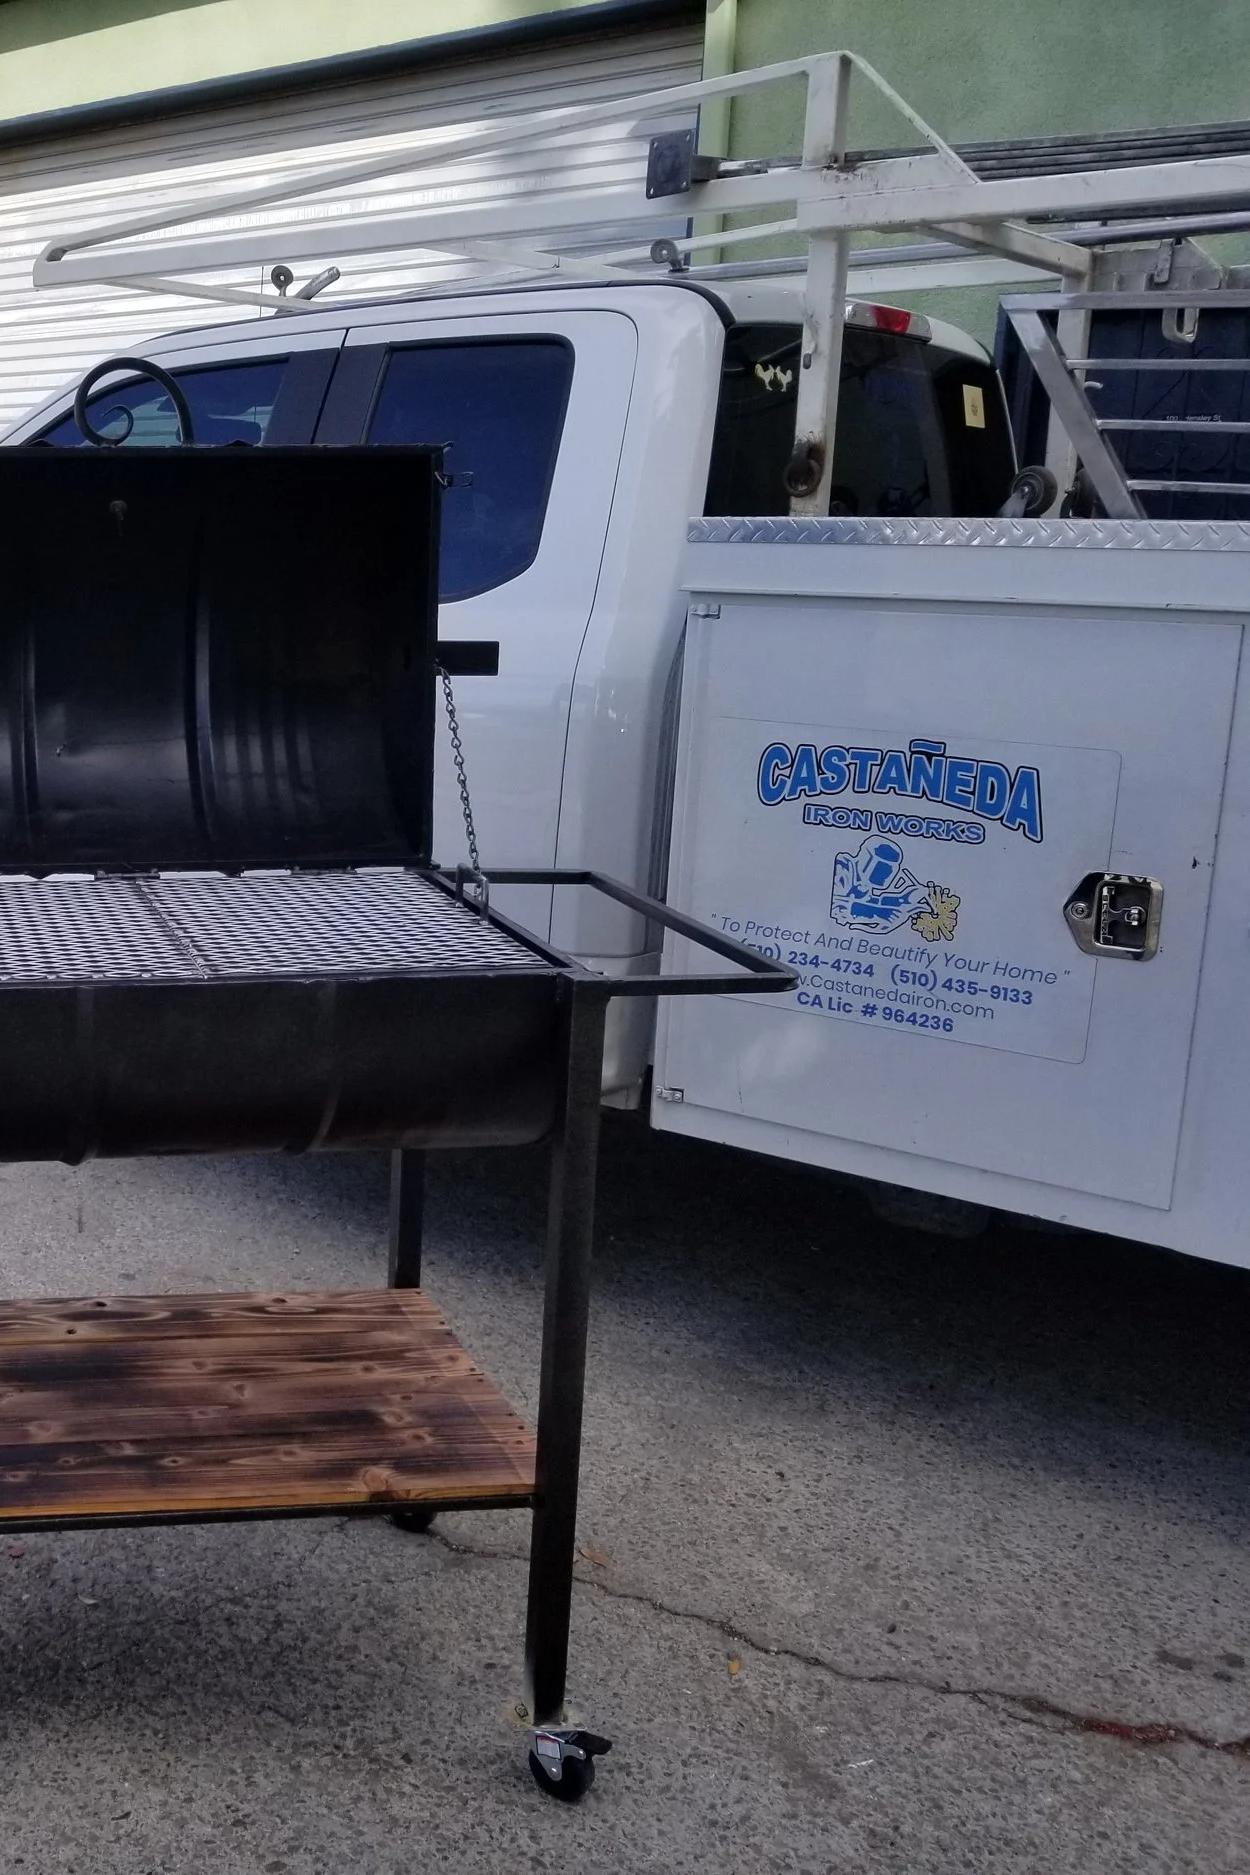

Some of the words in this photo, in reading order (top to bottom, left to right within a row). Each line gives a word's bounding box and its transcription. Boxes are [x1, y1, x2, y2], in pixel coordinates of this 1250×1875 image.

[757, 739, 1043, 843] CASTAÑEDA
[803, 804, 872, 830] IRON
[876, 812, 985, 844] WORKS
[745, 920, 811, 944] Protect
[814, 933, 853, 951] And
[856, 939, 939, 969] Beautify
[943, 952, 989, 974] Your
[993, 960, 1057, 985] Home
[788, 950, 875, 977] 234-4734
[890, 964, 937, 991] (510)
[941, 977, 1033, 1005] 435-9133
[797, 991, 823, 1009] CA
[827, 996, 853, 1013] Lic
[882, 1006, 954, 1032] 964236
